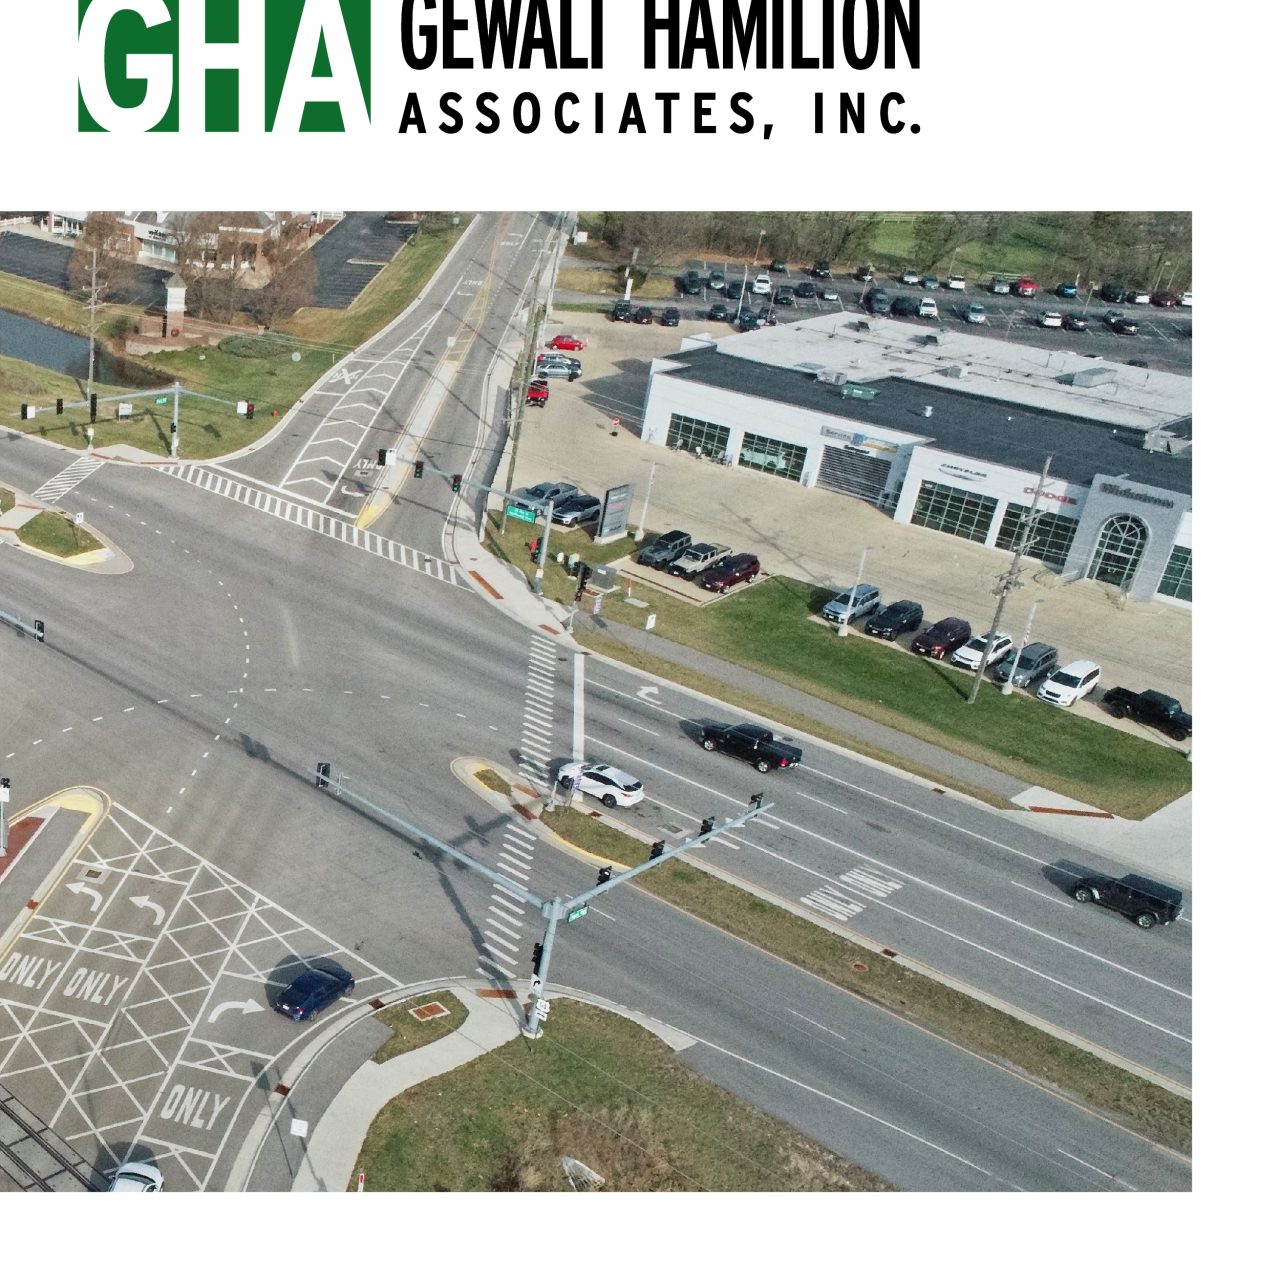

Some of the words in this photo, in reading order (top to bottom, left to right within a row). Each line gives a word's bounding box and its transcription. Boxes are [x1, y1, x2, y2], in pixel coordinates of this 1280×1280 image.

[800, 884, 868, 921] ONLY
[63, 967, 129, 1006] ONLY
[160, 1084, 231, 1131] ONLY
